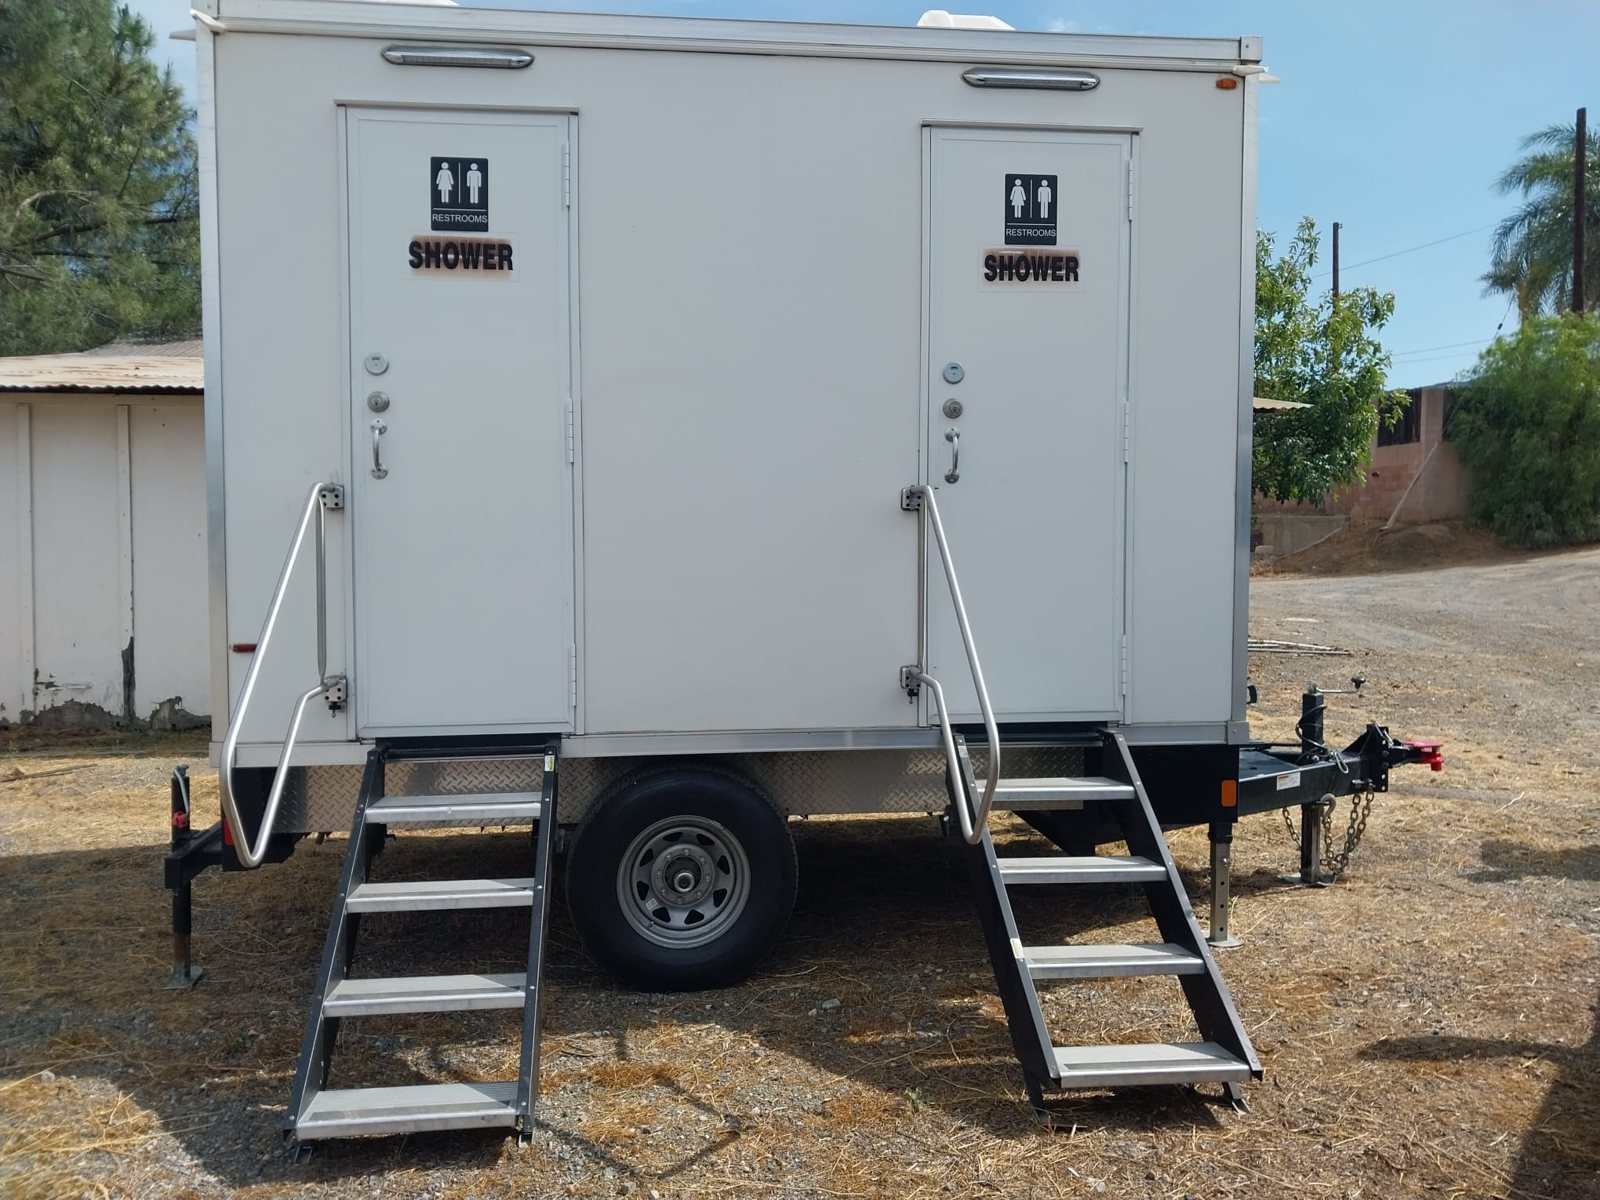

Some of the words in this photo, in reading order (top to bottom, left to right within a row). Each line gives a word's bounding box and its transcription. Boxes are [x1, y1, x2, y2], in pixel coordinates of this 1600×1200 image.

[432, 213, 488, 223] RESTROOMS
[1006, 228, 1056, 237] RESTROOMS
[408, 241, 513, 270] SHOWER
[984, 255, 1079, 282] SHOWER
